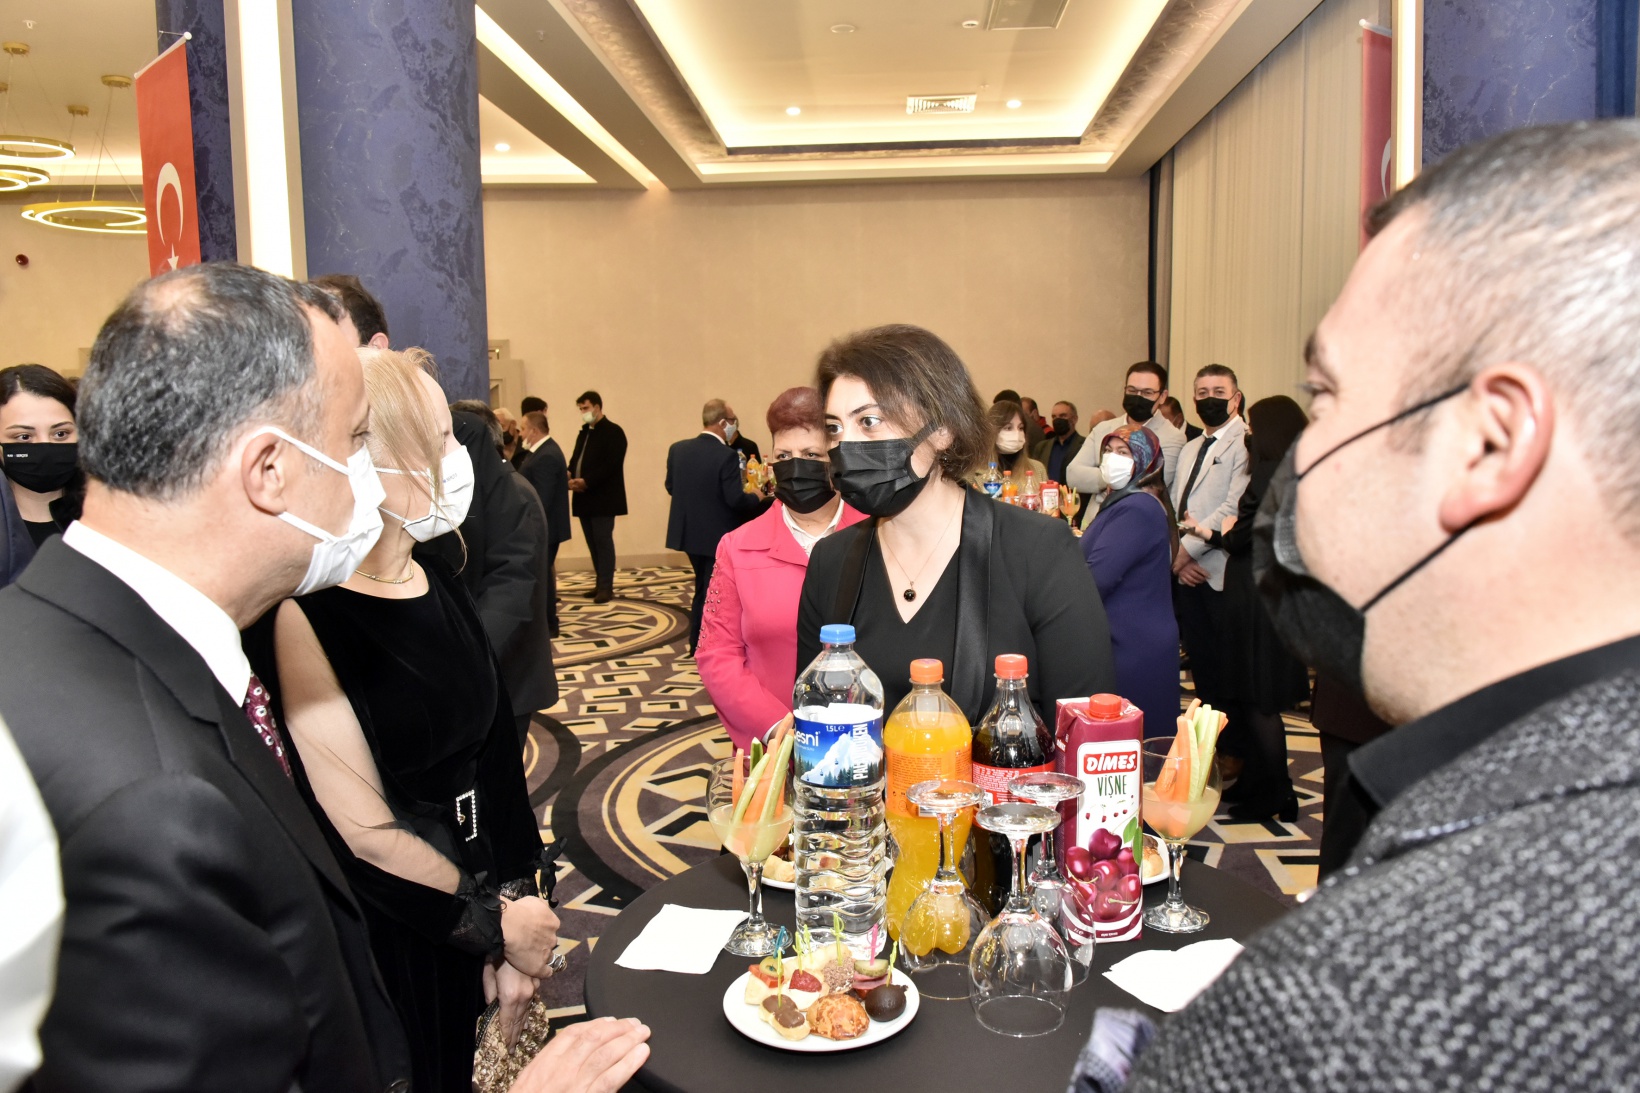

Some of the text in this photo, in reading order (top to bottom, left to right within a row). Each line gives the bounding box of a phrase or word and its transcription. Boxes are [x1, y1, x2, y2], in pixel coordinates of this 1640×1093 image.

[795, 730, 819, 747] esni
[1086, 753, 1136, 772] DİMES
[1097, 775, 1127, 798] VİŞNE
